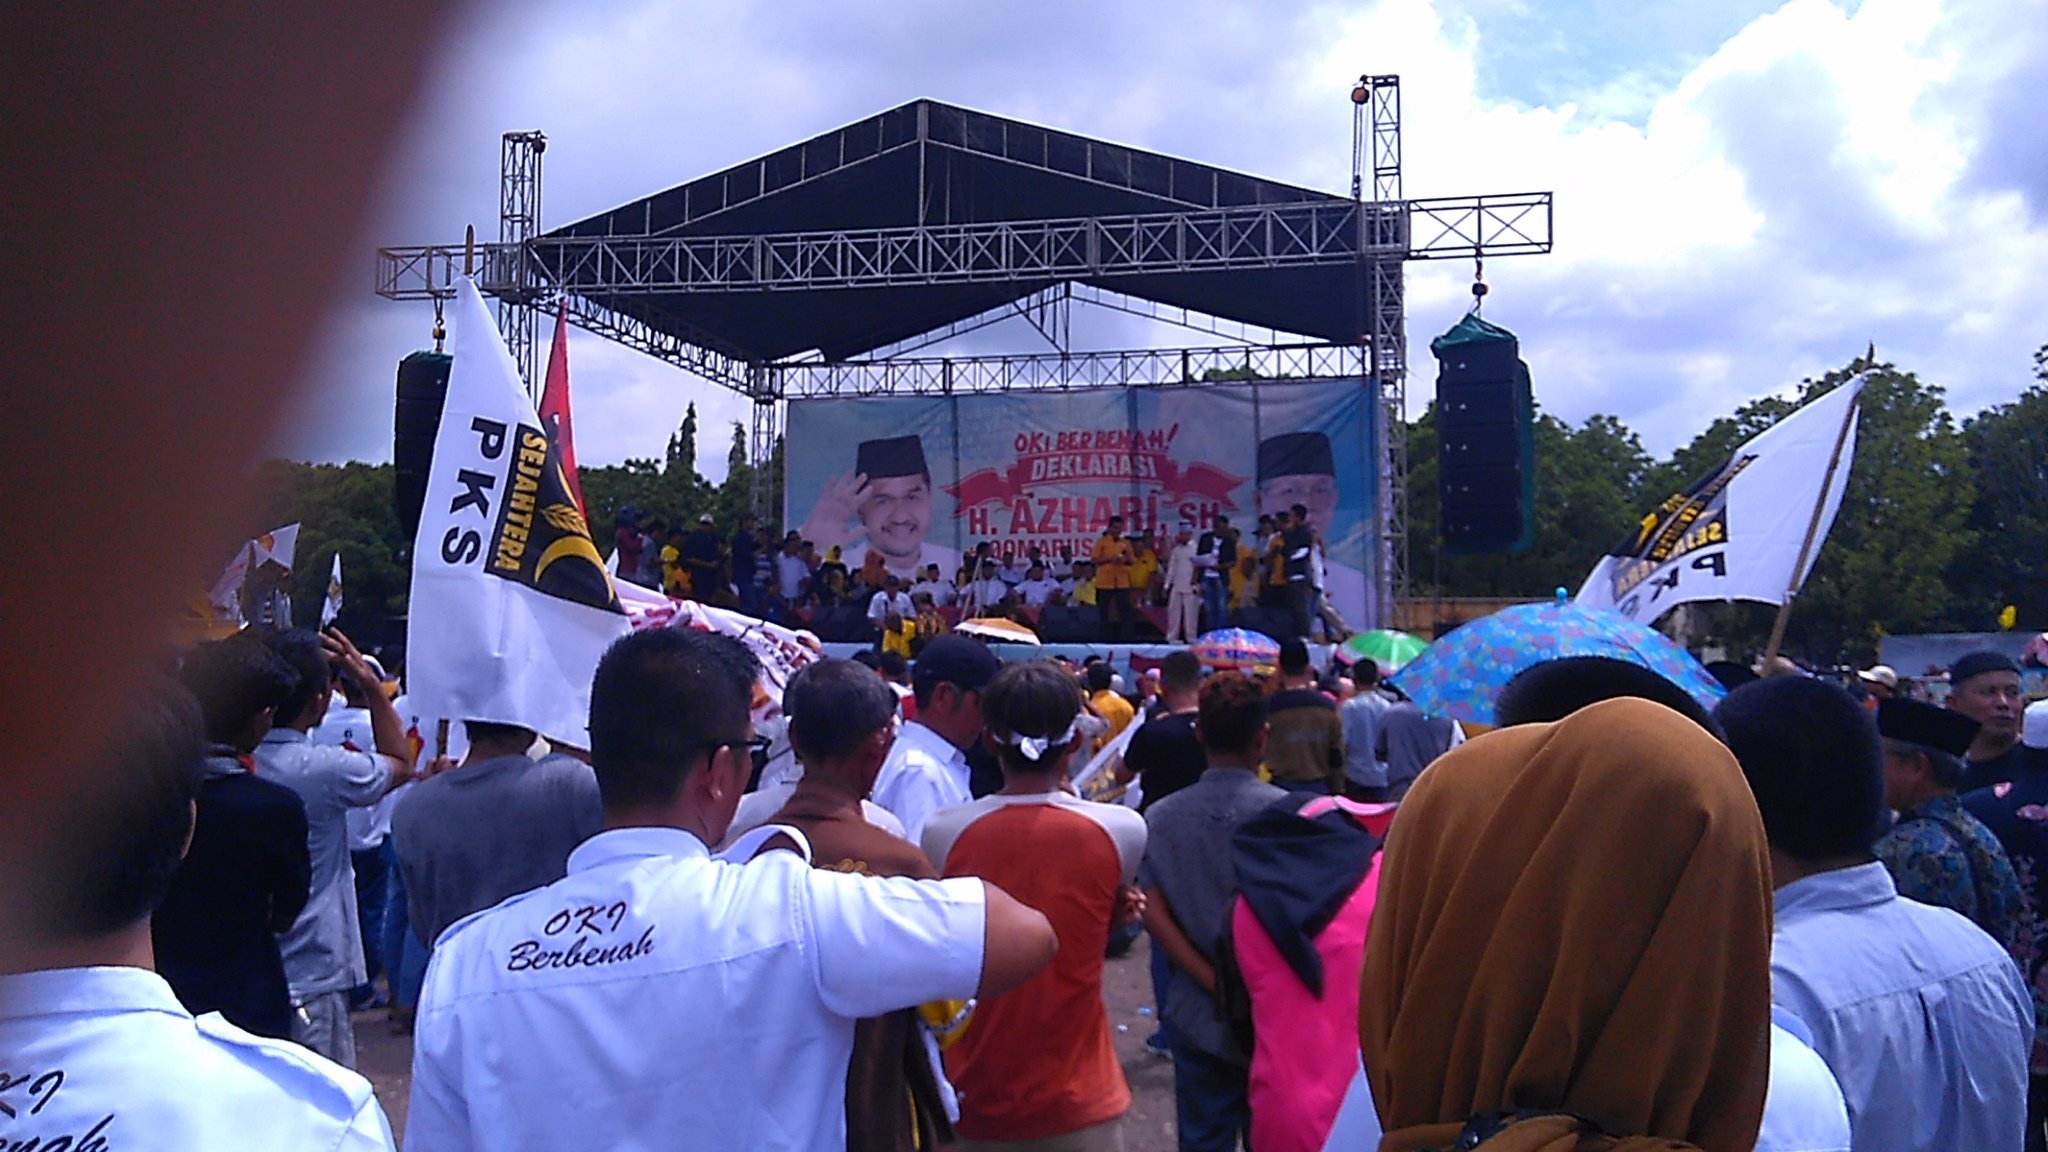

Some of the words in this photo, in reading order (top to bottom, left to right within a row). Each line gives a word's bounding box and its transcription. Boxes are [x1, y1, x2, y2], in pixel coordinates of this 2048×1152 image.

[1014, 431, 1050, 451] OKI
[1030, 454, 1157, 481] DEKLARASI
[441, 416, 508, 565] PKS
[494, 431, 548, 572] SEJAHTERA
[968, 506, 998, 535] H.
[544, 901, 627, 936] OKI
[507, 924, 656, 971] Berbenah
